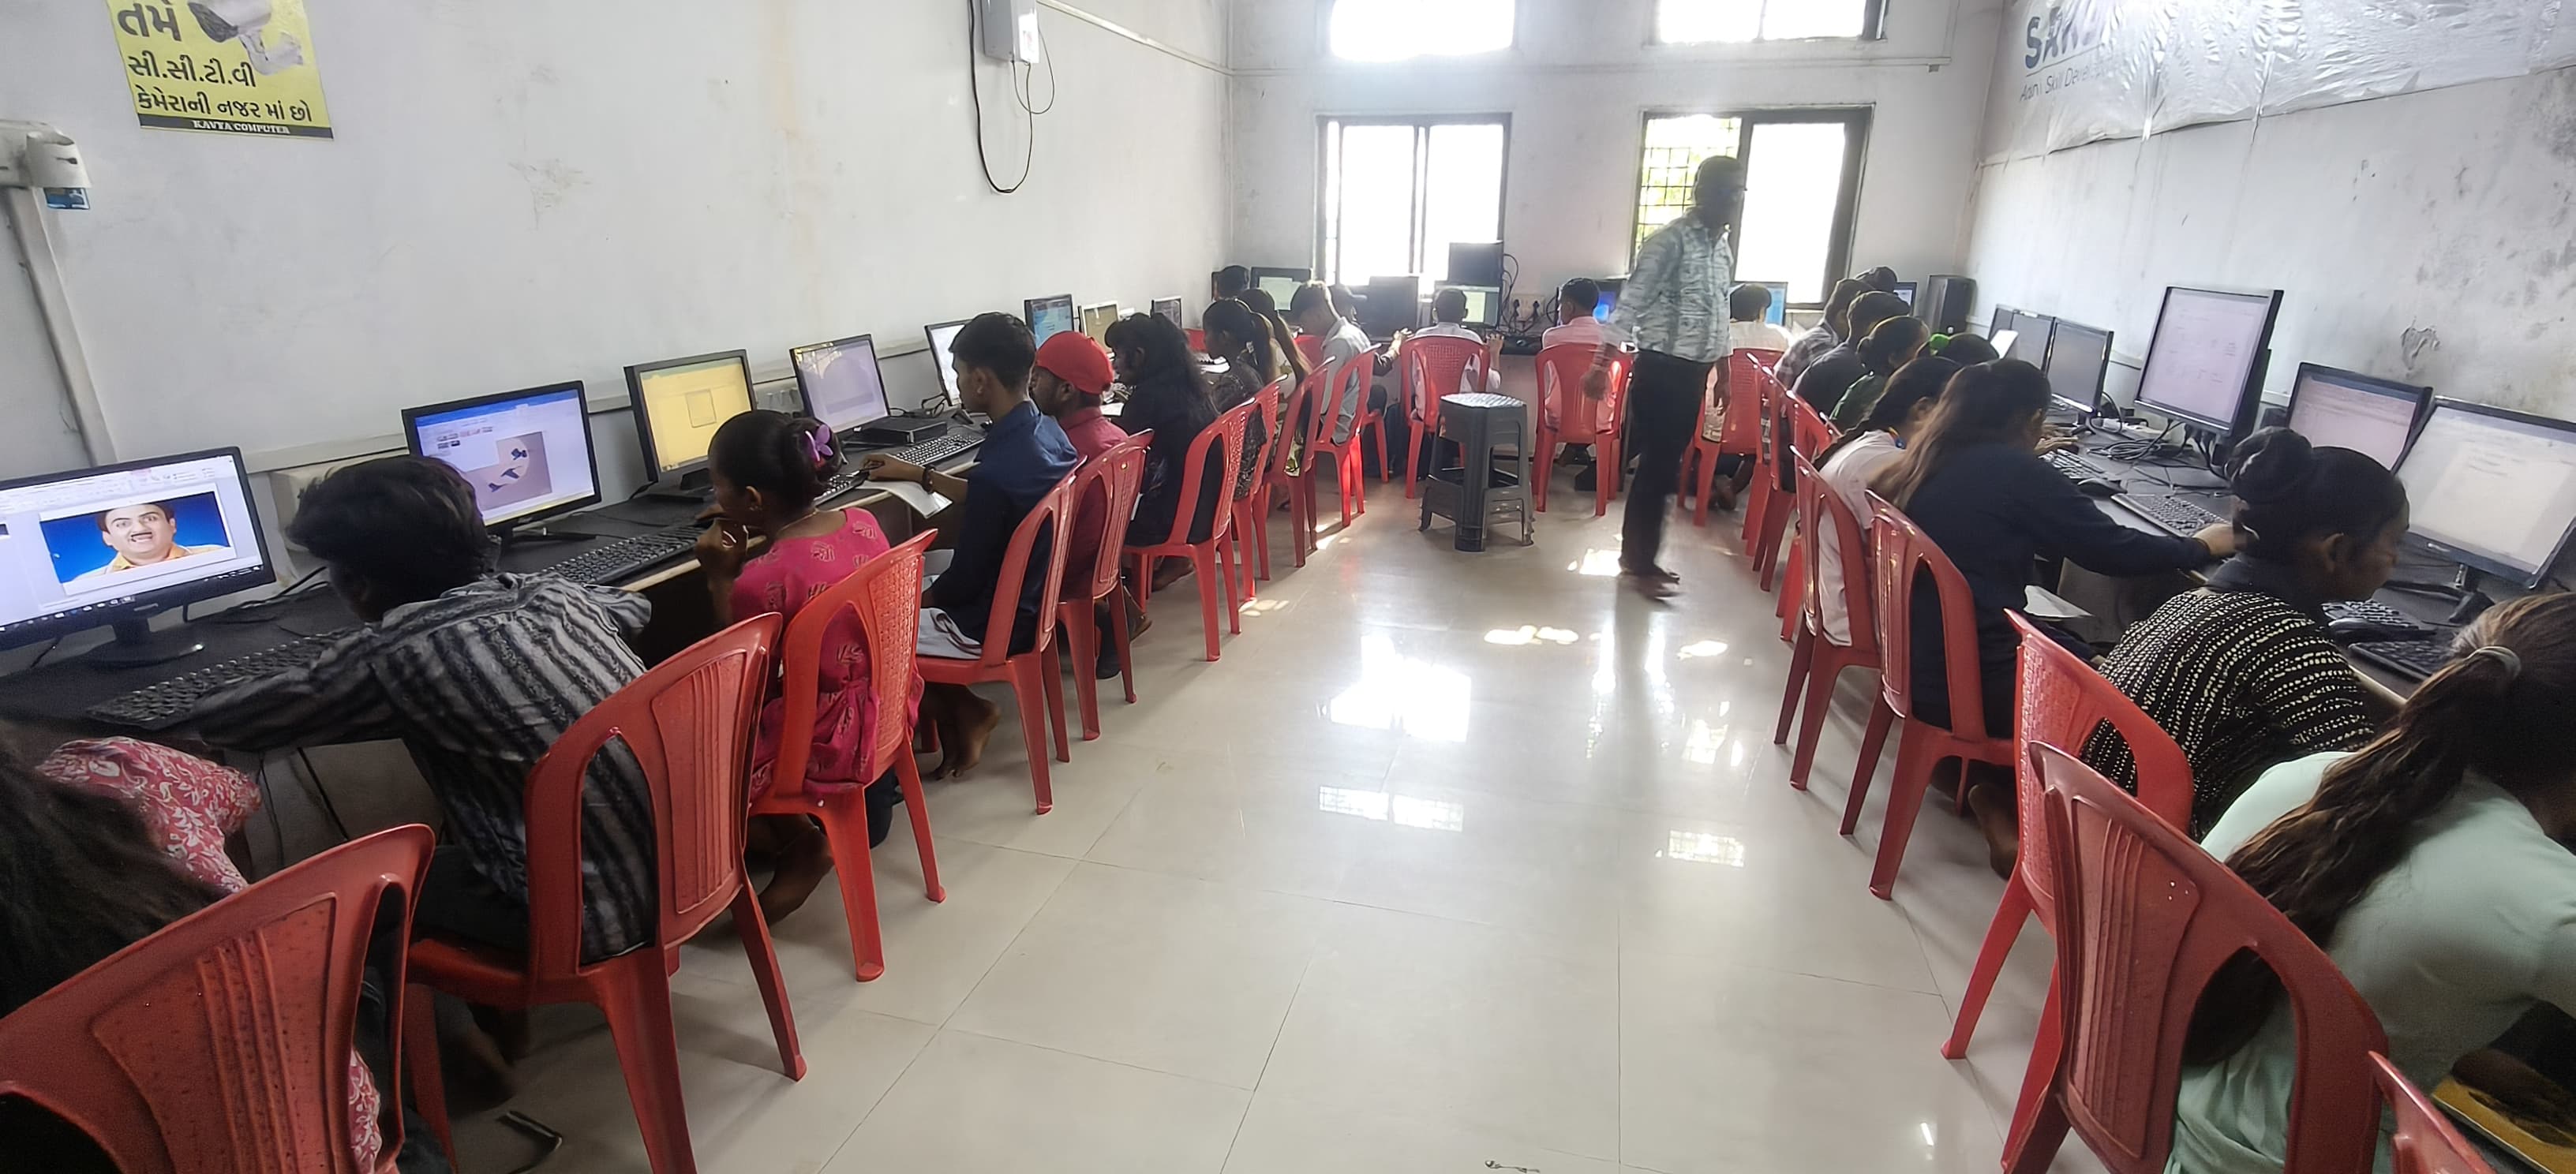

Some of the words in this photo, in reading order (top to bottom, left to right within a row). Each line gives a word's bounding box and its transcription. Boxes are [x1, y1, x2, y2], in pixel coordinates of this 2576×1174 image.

[135, 84, 212, 114] કેમેરાની
[216, 100, 261, 118] નજર
[290, 99, 313, 122] છો
[193, 120, 236, 132] KAVYA
[236, 123, 290, 134] COMPUTER
